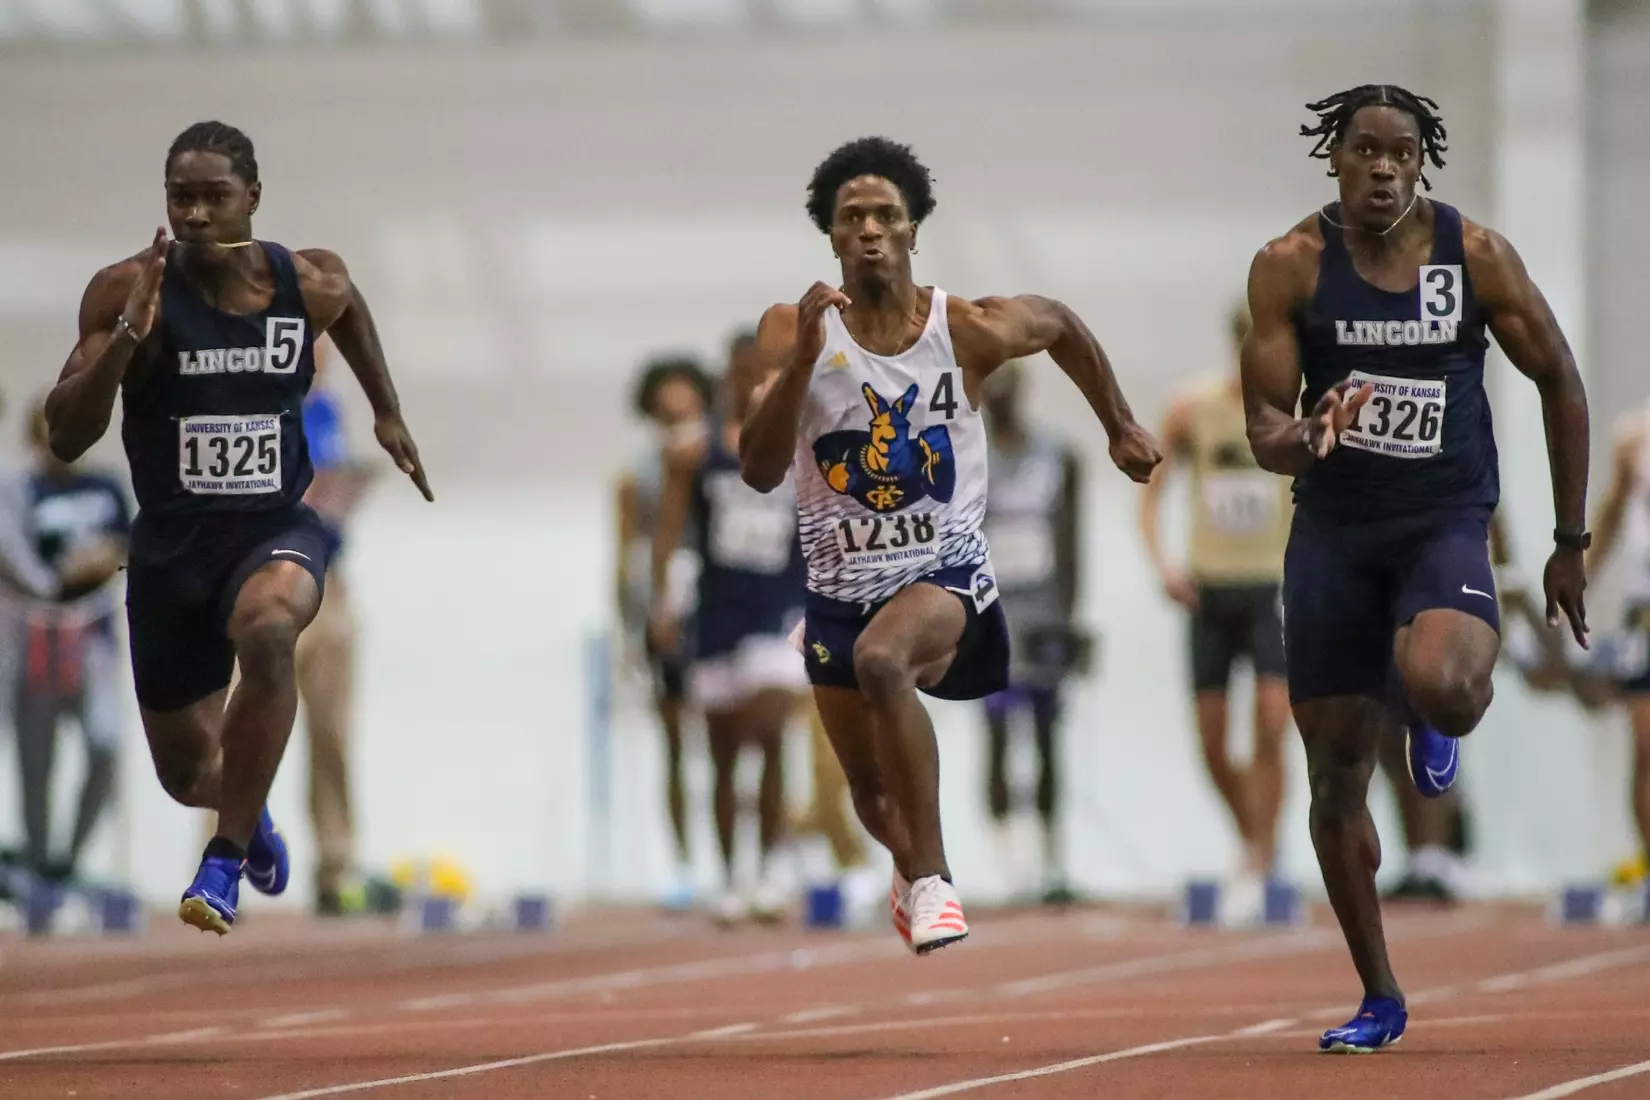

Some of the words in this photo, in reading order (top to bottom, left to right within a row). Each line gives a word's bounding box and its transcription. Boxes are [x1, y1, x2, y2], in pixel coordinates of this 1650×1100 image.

[1425, 268, 1456, 317] 3
[271, 321, 299, 369] 5
[1335, 320, 1458, 346] LINCOLN
[178, 346, 267, 376] LINCO
[929, 371, 958, 420] 4
[1398, 385, 1410, 397] OF
[1410, 387, 1440, 399] KANSAS
[185, 423, 232, 434] UNIVERSITY
[233, 423, 244, 433] OF
[245, 419, 276, 432] KANSAS
[184, 433, 278, 478] 1325
[187, 480, 225, 490] JAYHAWK
[225, 479, 276, 490] INVITATIONAL
[838, 512, 935, 553] 1238
[848, 554, 885, 566] JAYHAWK
[885, 546, 936, 562] INVITATIONAL
